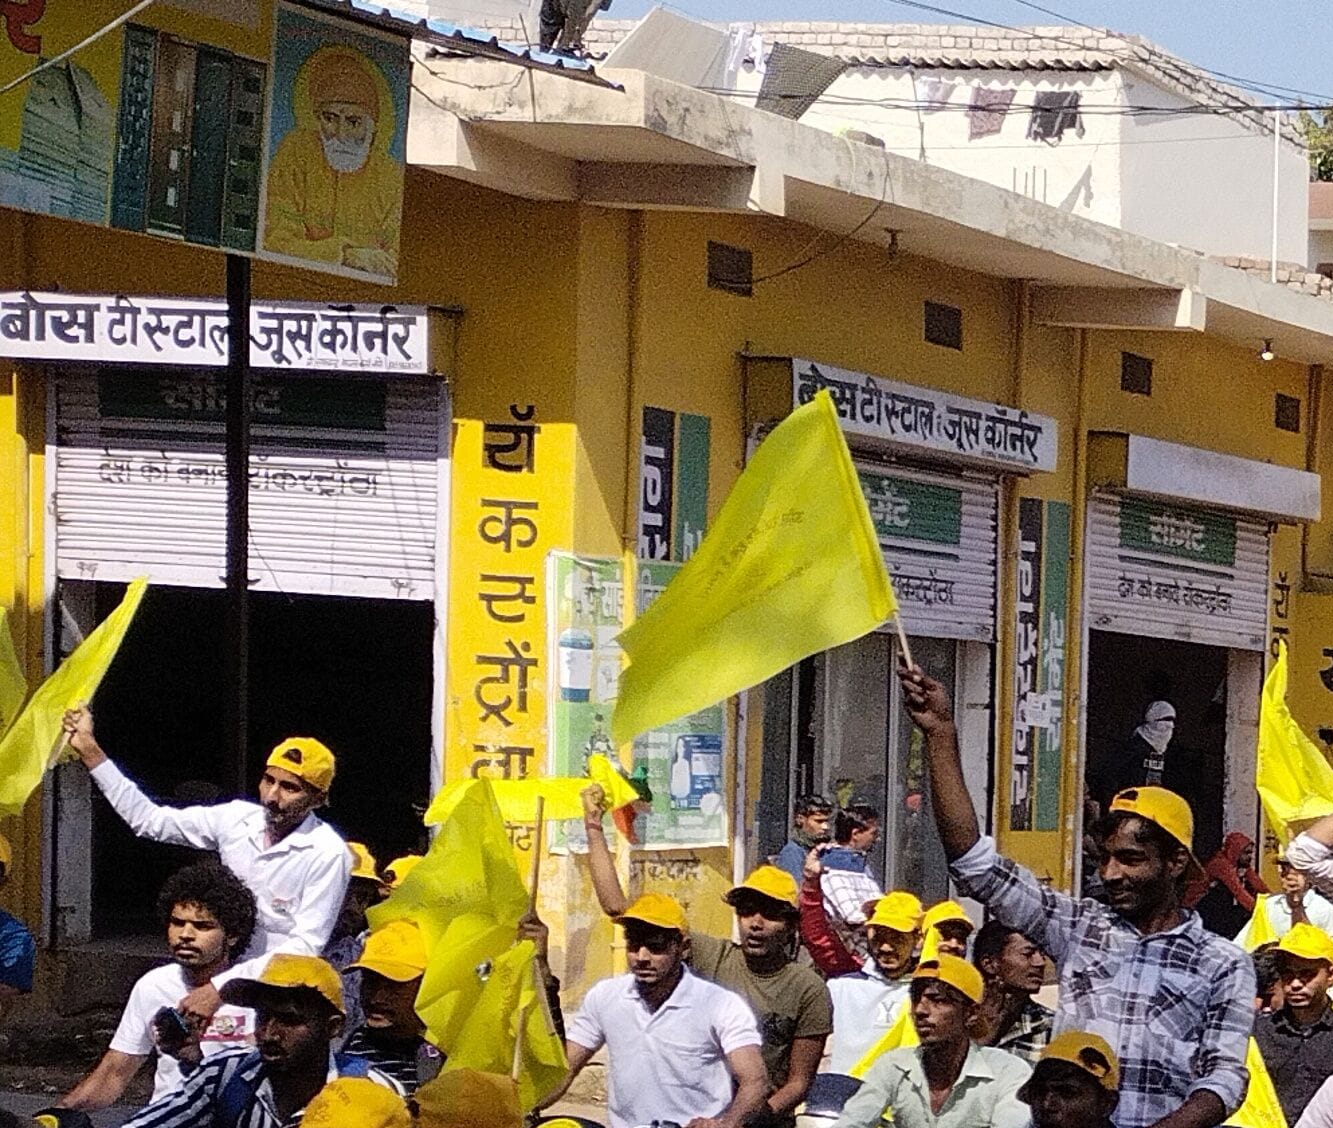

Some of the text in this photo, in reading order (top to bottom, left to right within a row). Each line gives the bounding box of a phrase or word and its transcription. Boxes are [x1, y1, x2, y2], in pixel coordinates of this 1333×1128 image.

[0, 291, 99, 345] बोस
[107, 295, 140, 347] टी
[249, 309, 316, 366] जूस
[317, 304, 419, 361] कॉर्नर
[860, 376, 883, 426] टी
[884, 392, 935, 441] स्टाल
[943, 404, 983, 452] जूस
[984, 406, 1044, 463] कॉर्नर
